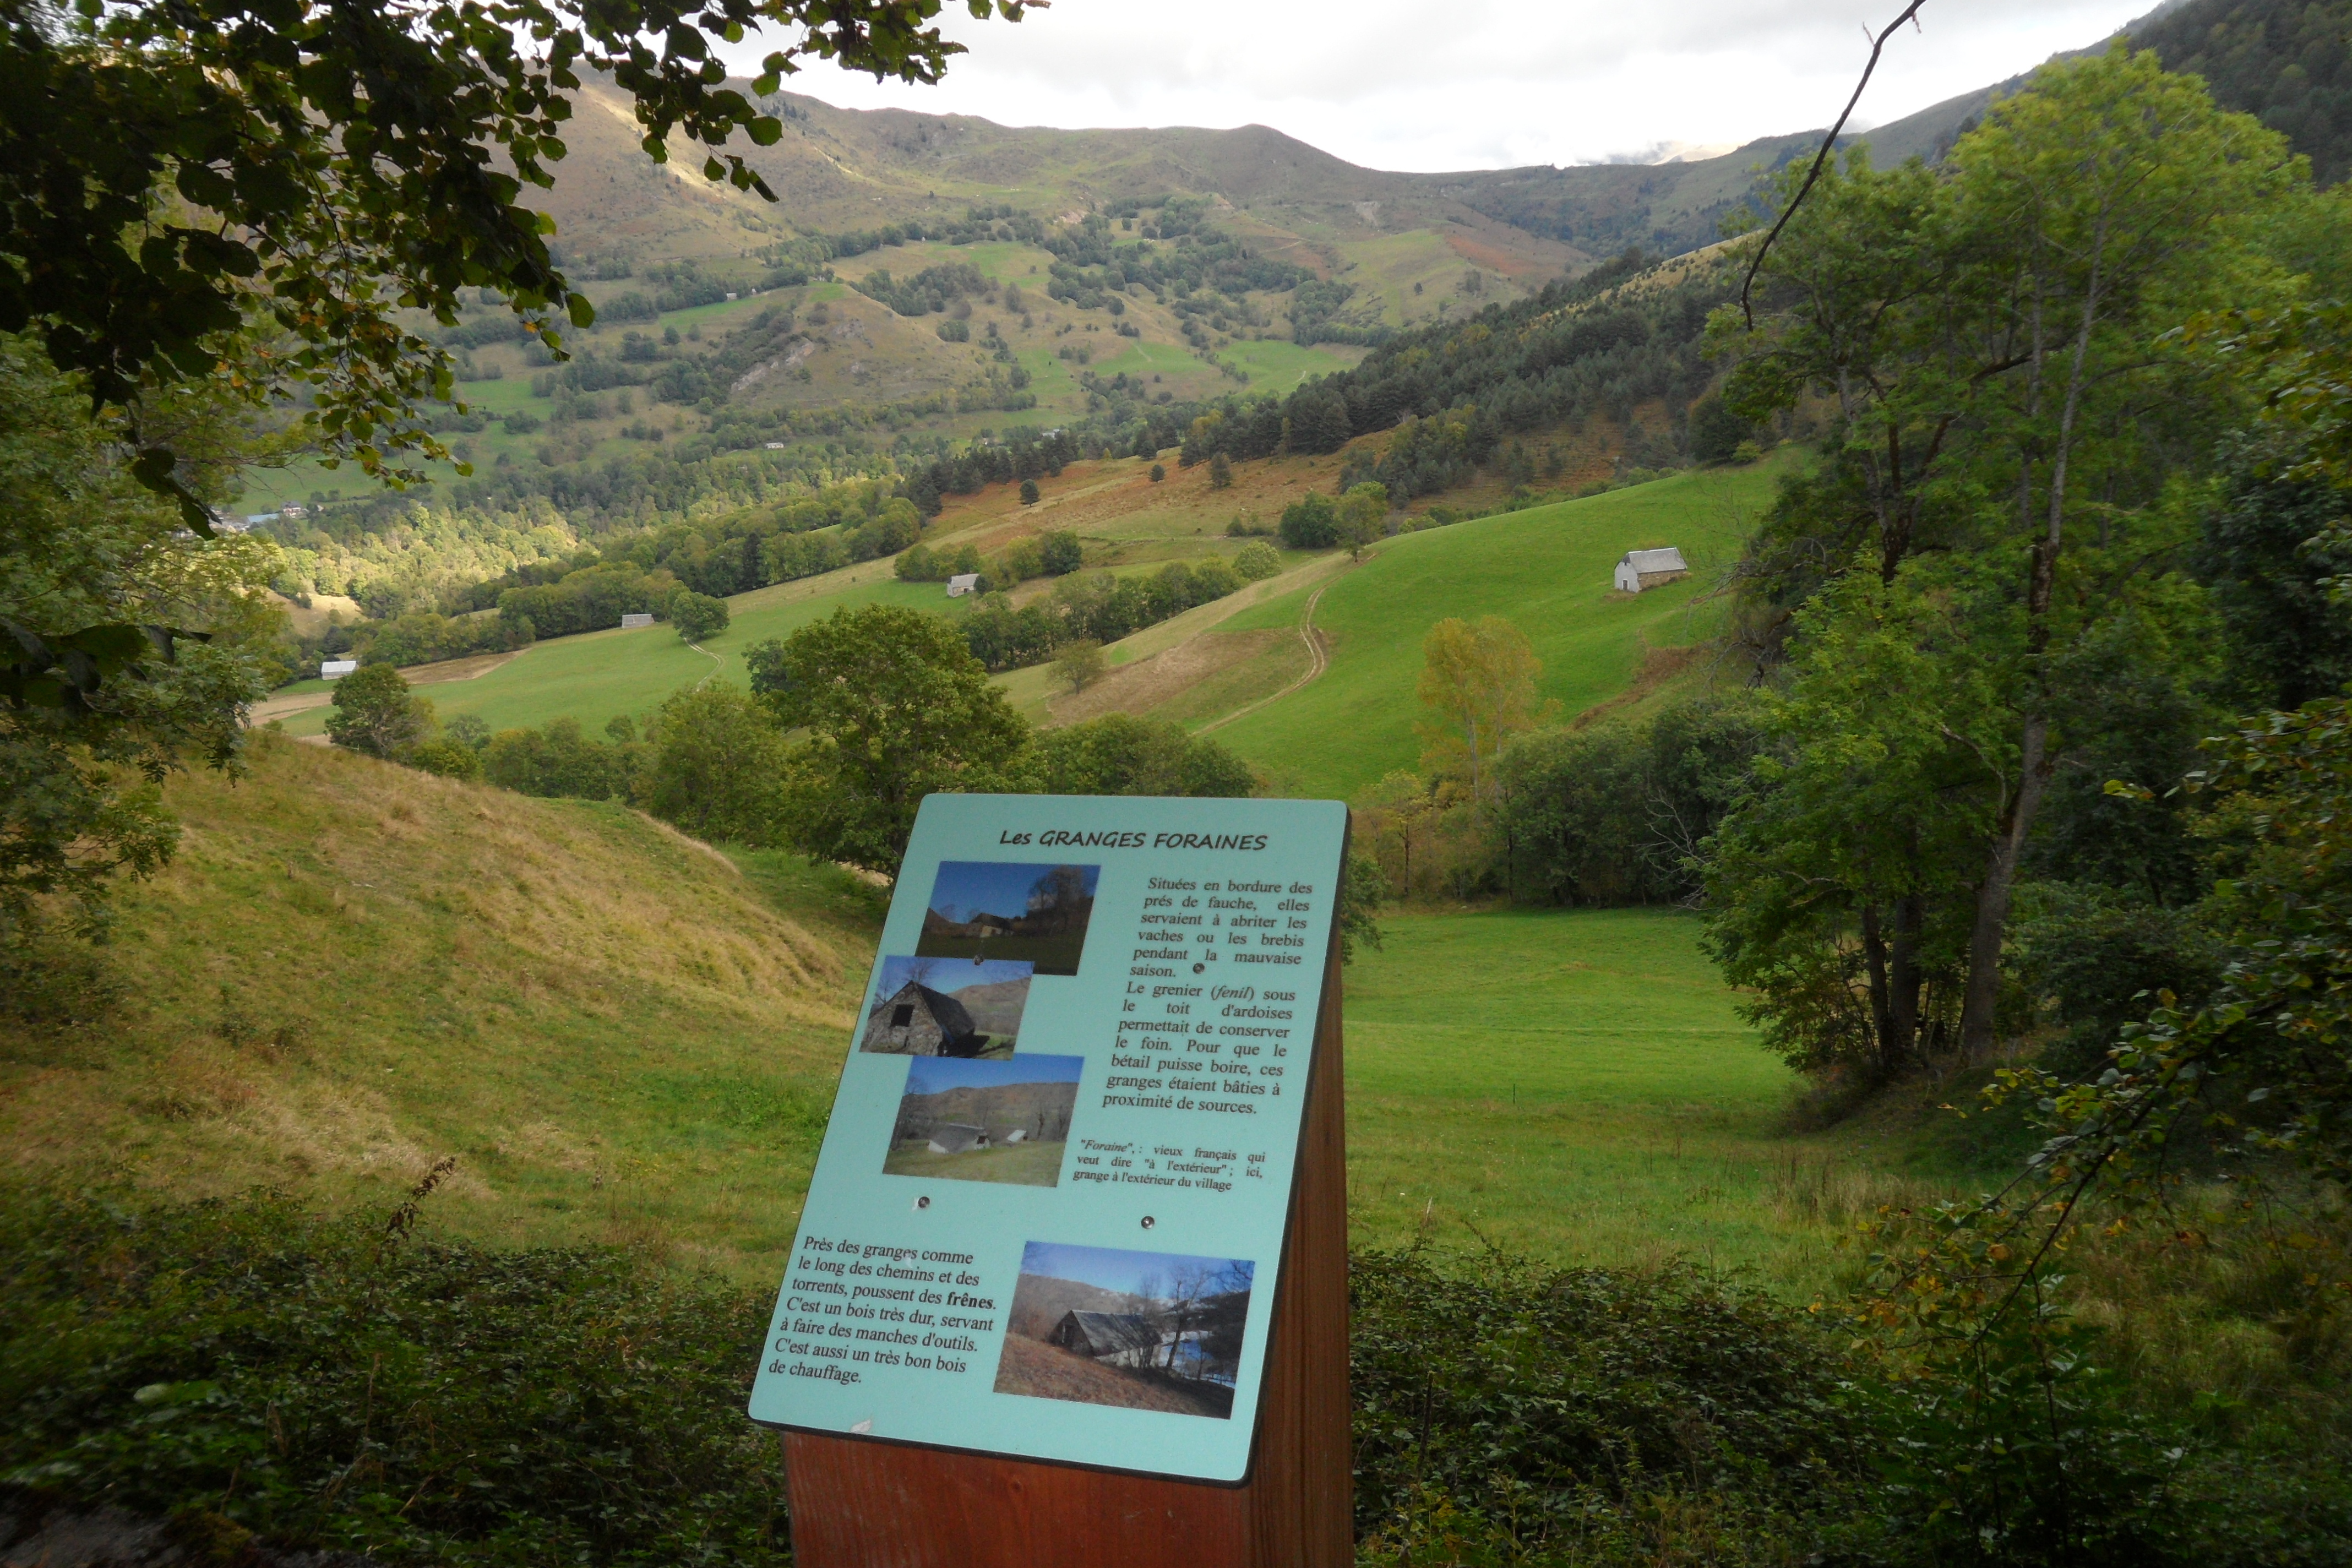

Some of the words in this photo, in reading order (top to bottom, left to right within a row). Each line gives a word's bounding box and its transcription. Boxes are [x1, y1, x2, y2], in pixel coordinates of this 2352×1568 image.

[1000, 830, 1032, 845] Les
[1039, 830, 1146, 848] GRANGES
[1153, 833, 1268, 851] FORAINES
[1148, 878, 1196, 890] Situées
[1204, 883, 1219, 891] en
[1228, 880, 1282, 893] bordure
[1289, 881, 1312, 894] des
[1144, 895, 1172, 909] prés
[1182, 896, 1198, 907] de
[1208, 896, 1256, 911] fauche,
[1278, 899, 1309, 911] elles
[1141, 913, 1202, 925] servaient
[1212, 914, 1219, 925] à
[1231, 915, 1277, 928] abriter
[1287, 917, 1306, 929] les
[1138, 929, 1183, 942] vaches
[1197, 934, 1214, 943] ou
[1228, 932, 1246, 944] les
[1261, 933, 1304, 946] brebis
[1133, 948, 1188, 961] pendant
[1205, 949, 1217, 961] la
[1234, 952, 1302, 965] mauvaise
[1130, 964, 1176, 977] saison.
[1126, 981, 1145, 994] Le
[1152, 984, 1203, 998] grenier
[1211, 986, 1254, 1001] (fenil)
[1263, 991, 1295, 1001] sous
[1123, 999, 1135, 1011] le
[1167, 1002, 1190, 1014] toit
[1221, 1004, 1292, 1020] d'ardoises
[1118, 1020, 1190, 1033] permettait
[1196, 1021, 1213, 1034] de
[1219, 1026, 1291, 1038] conserver
[1115, 1035, 1128, 1048] le
[1141, 1037, 1172, 1050] foin.
[1186, 1039, 1221, 1053] Pour
[1234, 1046, 1260, 1058] que
[1273, 1044, 1287, 1057] le
[1111, 1054, 1150, 1068] bétail
[1157, 1058, 1202, 1072] puisse
[1211, 1059, 1251, 1076] boire,
[1260, 1066, 1283, 1076] ces
[1106, 1076, 1162, 1091] granges
[1168, 1076, 1217, 1091] étaient
[1223, 1080, 1265, 1095] bâties
[1272, 1083, 1280, 1096] à
[1102, 1094, 1173, 1108] proximité
[1177, 1096, 1194, 1109] de
[1198, 1101, 1256, 1114] sources.
[1154, 1145, 1183, 1156] vieux
[1194, 1147, 1237, 1161] français
[1248, 1152, 1265, 1164] qui
[1077, 1156, 1099, 1165] veut
[1111, 1157, 1131, 1167] dire
[1145, 1159, 1155, 1169] "à
[1167, 1161, 1227, 1174] l'extérieur"
[1246, 1166, 1262, 1179] ici,
[1072, 1171, 1109, 1183] grange
[1112, 1172, 1118, 1182] à
[1121, 1172, 1175, 1185] l'extérieur
[1178, 1177, 1191, 1187] du
[1195, 1178, 1232, 1193] village
[803, 1236, 833, 1251] Près
[837, 1239, 860, 1254] des
[862, 1245, 918, 1261] granges
[922, 1251, 973, 1264] comme
[798, 1256, 810, 1269] le
[814, 1257, 846, 1276] long
[850, 1261, 872, 1276] des
[876, 1264, 934, 1282] chemins
[939, 1271, 952, 1283] et
[956, 1271, 979, 1286] des
[792, 1278, 847, 1297] torrents,
[851, 1286, 915, 1301] poussent
[918, 1289, 942, 1304] des
[946, 1292, 996, 1310] frênes.
[787, 1297, 821, 1313] C'est
[825, 1304, 841, 1315] un
[846, 1302, 875, 1319] bois
[880, 1307, 905, 1321] très
[909, 1309, 935, 1328] dur,
[940, 1316, 994, 1331] servant
[780, 1317, 788, 1331] à
[792, 1318, 825, 1335] faire
[829, 1322, 852, 1337] des
[856, 1329, 918, 1345] manches
[922, 1332, 977, 1352] d'outils.
[775, 1338, 809, 1354] C'est
[813, 1345, 848, 1359] aussi
[852, 1351, 869, 1362] un
[874, 1350, 900, 1365] très
[905, 1352, 932, 1369] bon
[936, 1355, 966, 1373] bois
[769, 1359, 786, 1374] de
[790, 1362, 861, 1385] chauffage.
